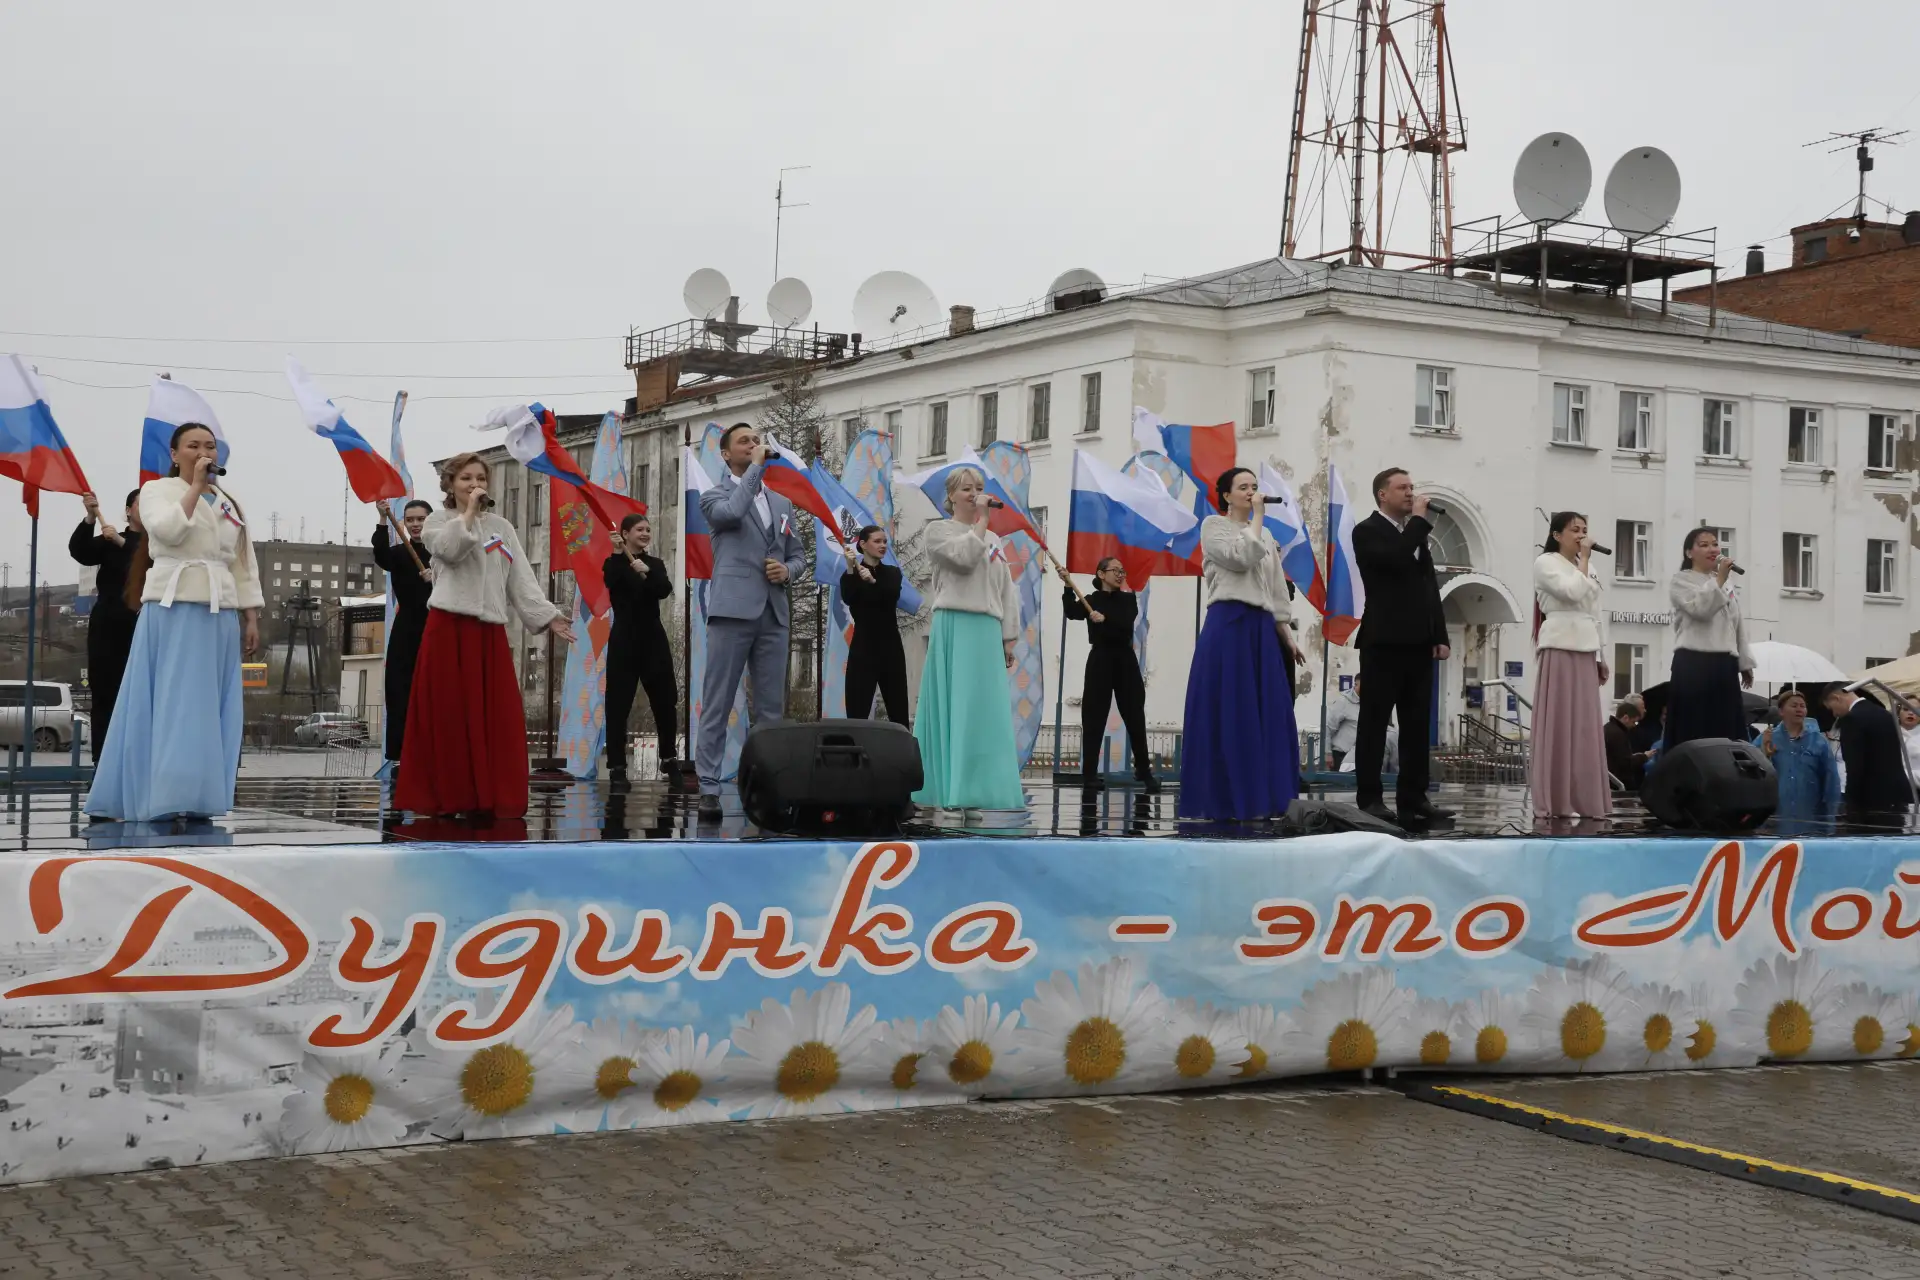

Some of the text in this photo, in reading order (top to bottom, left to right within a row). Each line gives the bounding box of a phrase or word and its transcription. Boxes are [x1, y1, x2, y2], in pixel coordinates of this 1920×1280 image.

[1612, 611, 1671, 626] ПОЧТА РОССИИ
[4, 842, 1030, 1047] Дудинка
[1241, 901, 1525, 957] это
